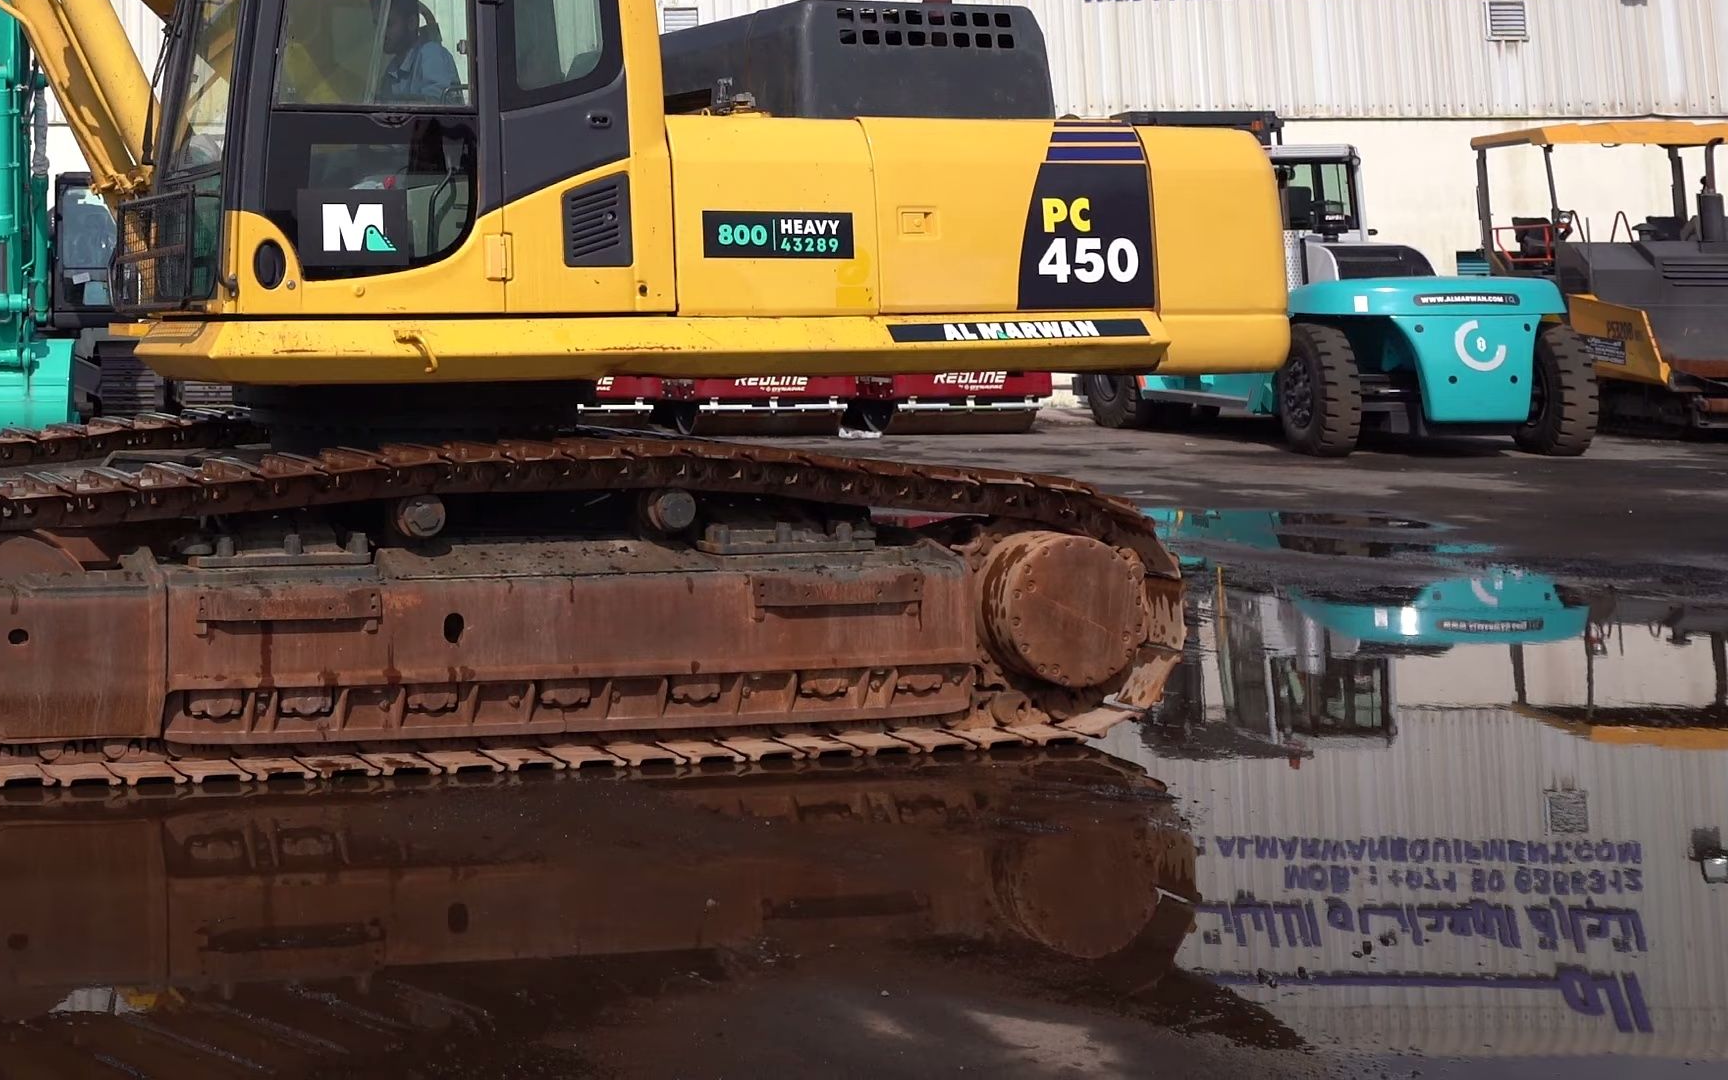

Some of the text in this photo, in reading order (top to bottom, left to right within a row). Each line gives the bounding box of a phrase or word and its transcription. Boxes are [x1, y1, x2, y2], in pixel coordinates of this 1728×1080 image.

[1041, 197, 1091, 233] PC
[717, 224, 768, 246] 800
[780, 219, 840, 236] HEAVY
[780, 236, 840, 253] 43289
[1038, 237, 1140, 284] 450
[943, 320, 1100, 341] AL MARWAN
[933, 371, 1008, 384] REDLINE
